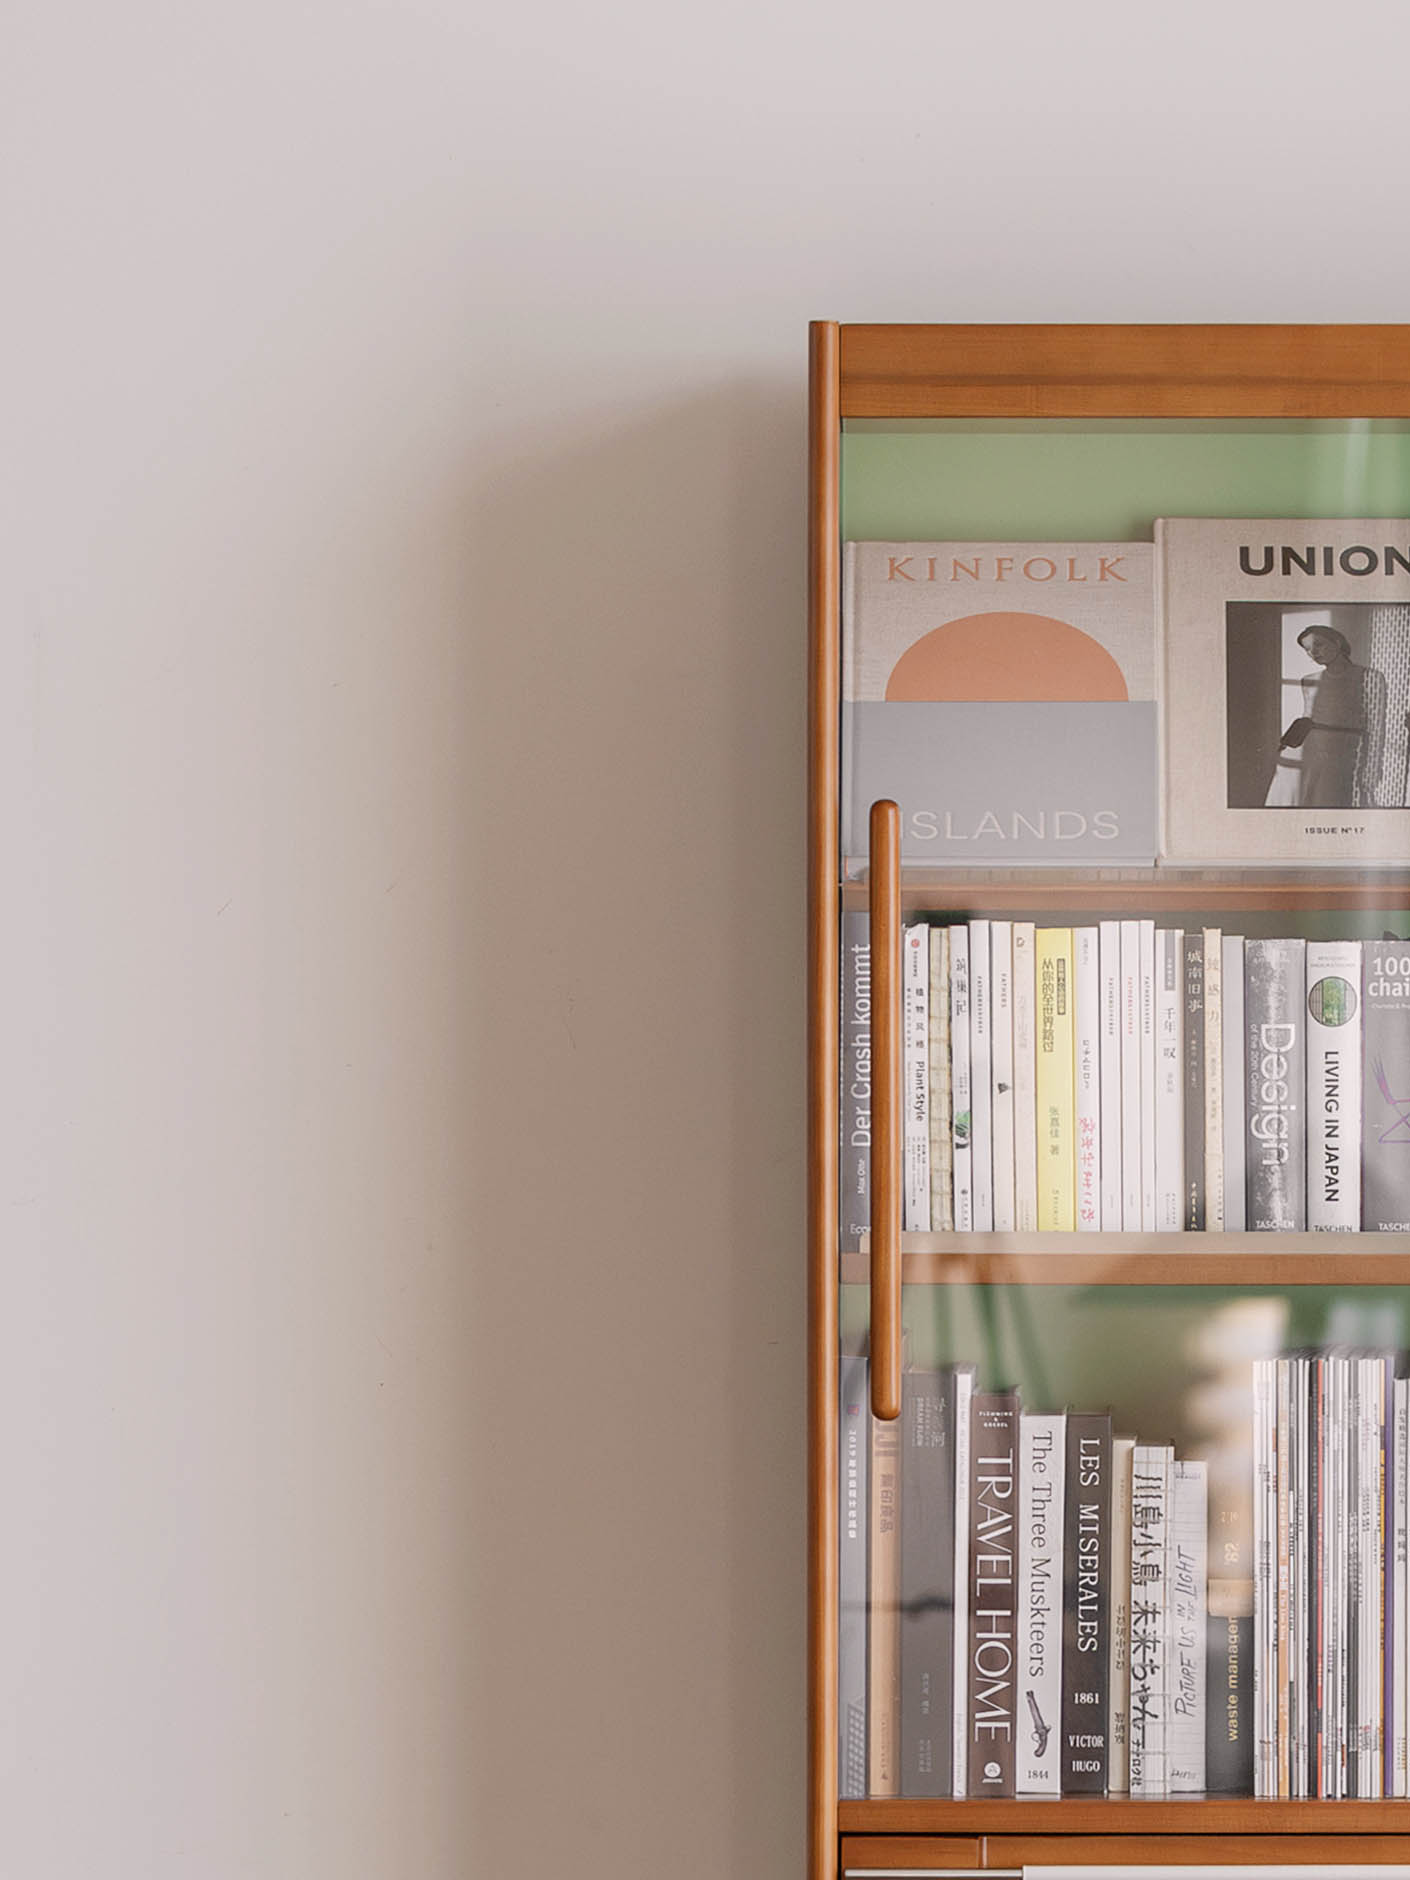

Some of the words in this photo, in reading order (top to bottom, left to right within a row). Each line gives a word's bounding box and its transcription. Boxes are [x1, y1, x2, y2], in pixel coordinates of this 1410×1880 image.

[886, 555, 1129, 583] KINFOLK
[1304, 825, 1338, 835] ISSUE
[851, 943, 872, 1025] kommt
[1041, 957, 1055, 1053] 从你的全世界路过
[1187, 950, 1203, 1013] 城南旧事
[851, 1032, 872, 1100] Crash
[915, 1060, 926, 1091] Plant
[1249, 1073, 1259, 1107] Century
[1324, 1050, 1340, 1114] LIVING
[915, 1093, 926, 1122] Style
[1250, 1023, 1297, 1166] Design
[851, 1106, 872, 1148] Der
[1324, 1119, 1340, 1139] IN
[1324, 1144, 1340, 1203] JAPAN
[1255, 1219, 1295, 1230] TASCHEN
[1031, 1430, 1053, 1474] The
[1079, 1437, 1101, 1489] LES
[974, 1447, 1014, 1597] TRAVEL
[1030, 1482, 1052, 1550] Three
[1132, 1472, 1164, 1588] 川島小鳥
[1175, 1544, 1198, 1600] LIGHT
[1028, 1558, 1052, 1678] Musketeers
[1177, 1603, 1186, 1618] IN
[1177, 1626, 1197, 1649] US
[974, 1610, 1013, 1743] HOME
[1073, 1692, 1100, 1704] 1861
[1174, 1651, 1197, 1717] PICTURE
[1068, 1734, 1105, 1749] VICTOR
[1225, 1694, 1239, 1742] waste
[1027, 1768, 1049, 1780] 1844
[1072, 1760, 1101, 1773] HUGO
